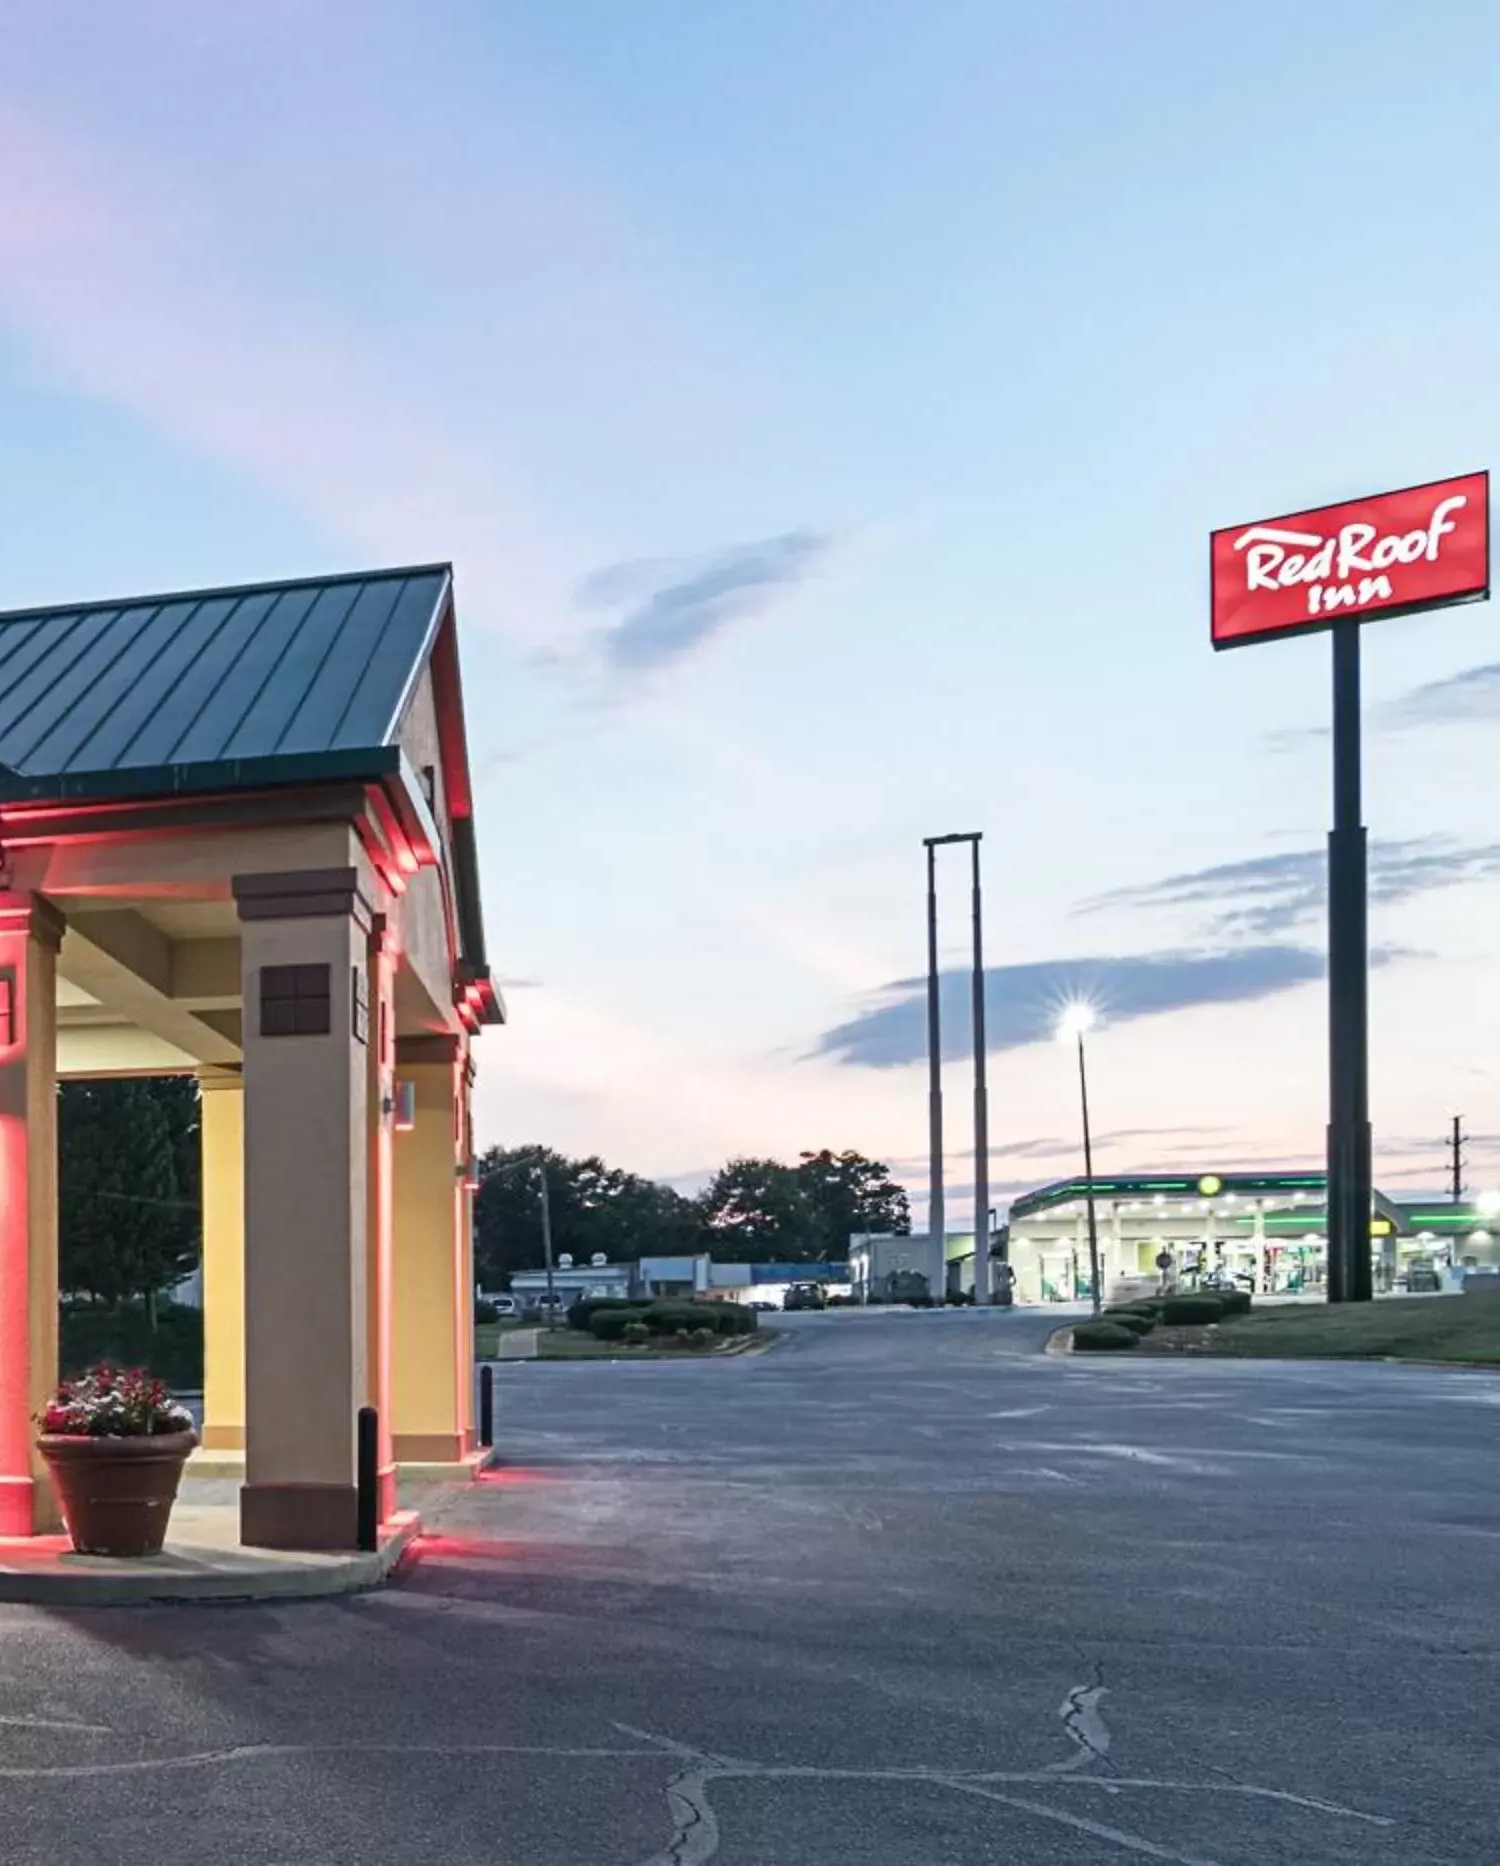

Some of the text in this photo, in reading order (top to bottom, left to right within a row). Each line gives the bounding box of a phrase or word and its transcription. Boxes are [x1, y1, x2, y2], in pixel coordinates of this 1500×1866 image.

[1246, 495, 1467, 591] Red Roof
[1307, 575, 1393, 615] Inn
